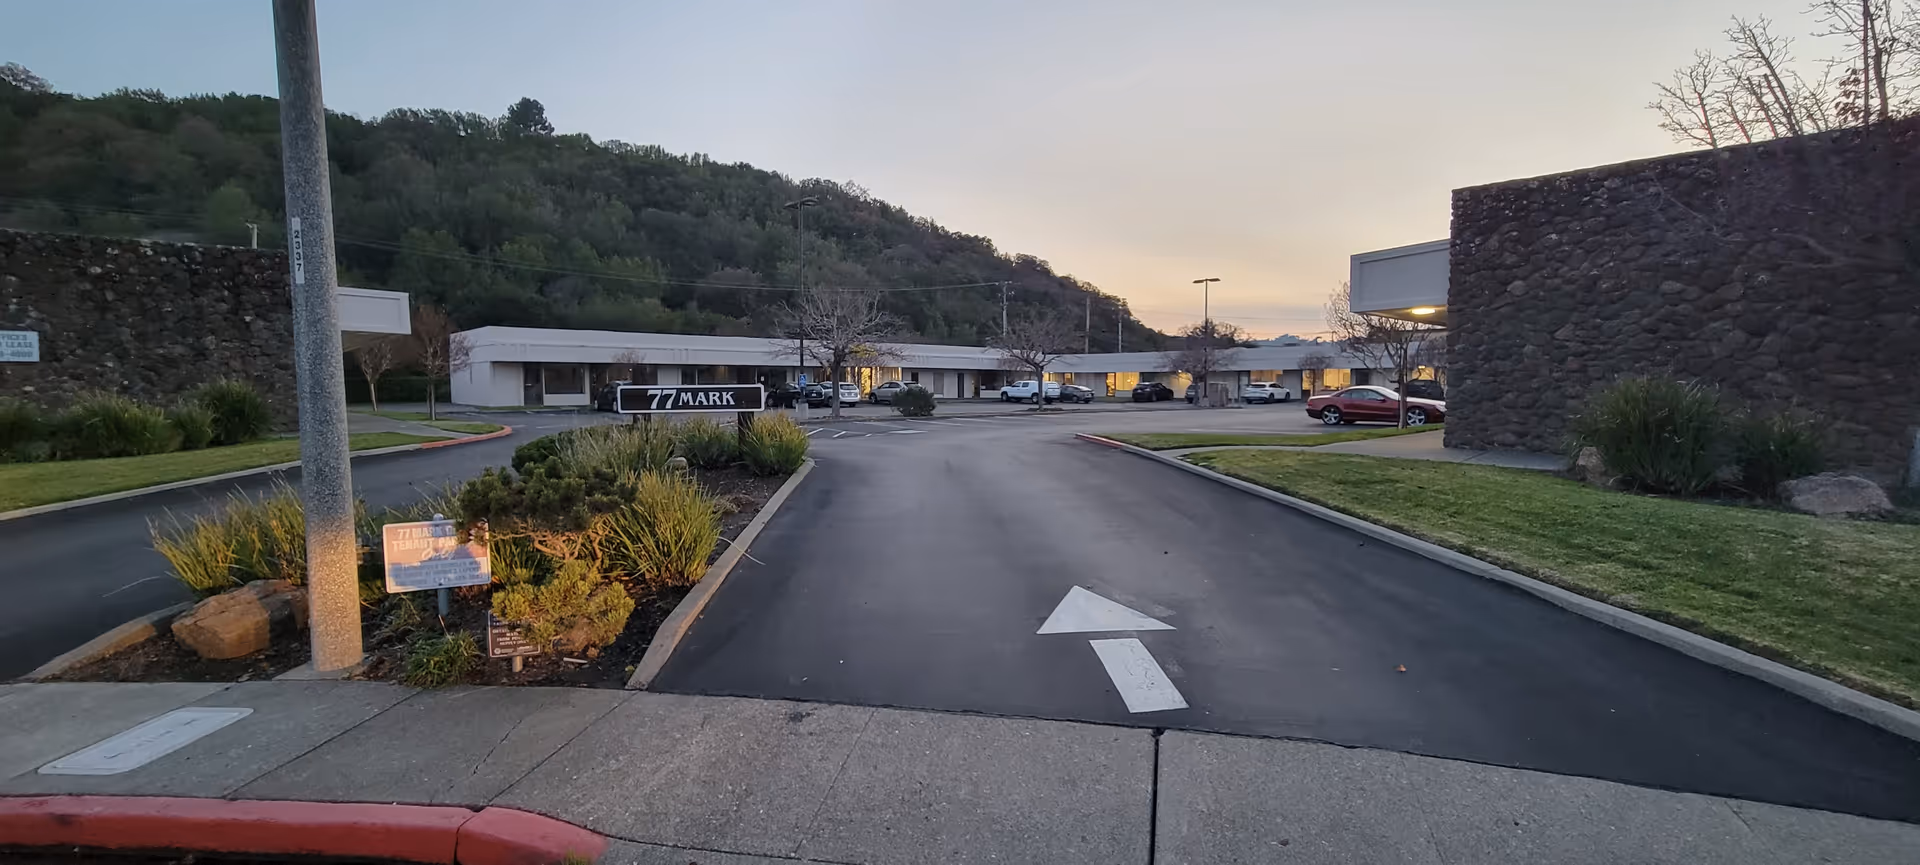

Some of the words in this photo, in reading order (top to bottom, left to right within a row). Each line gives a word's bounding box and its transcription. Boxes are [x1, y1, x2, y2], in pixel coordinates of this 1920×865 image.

[293, 230, 302, 272] 2337
[647, 389, 677, 410] 77
[679, 391, 735, 406] MARK
[397, 528, 411, 540] 77
[392, 538, 434, 552] TENANT
